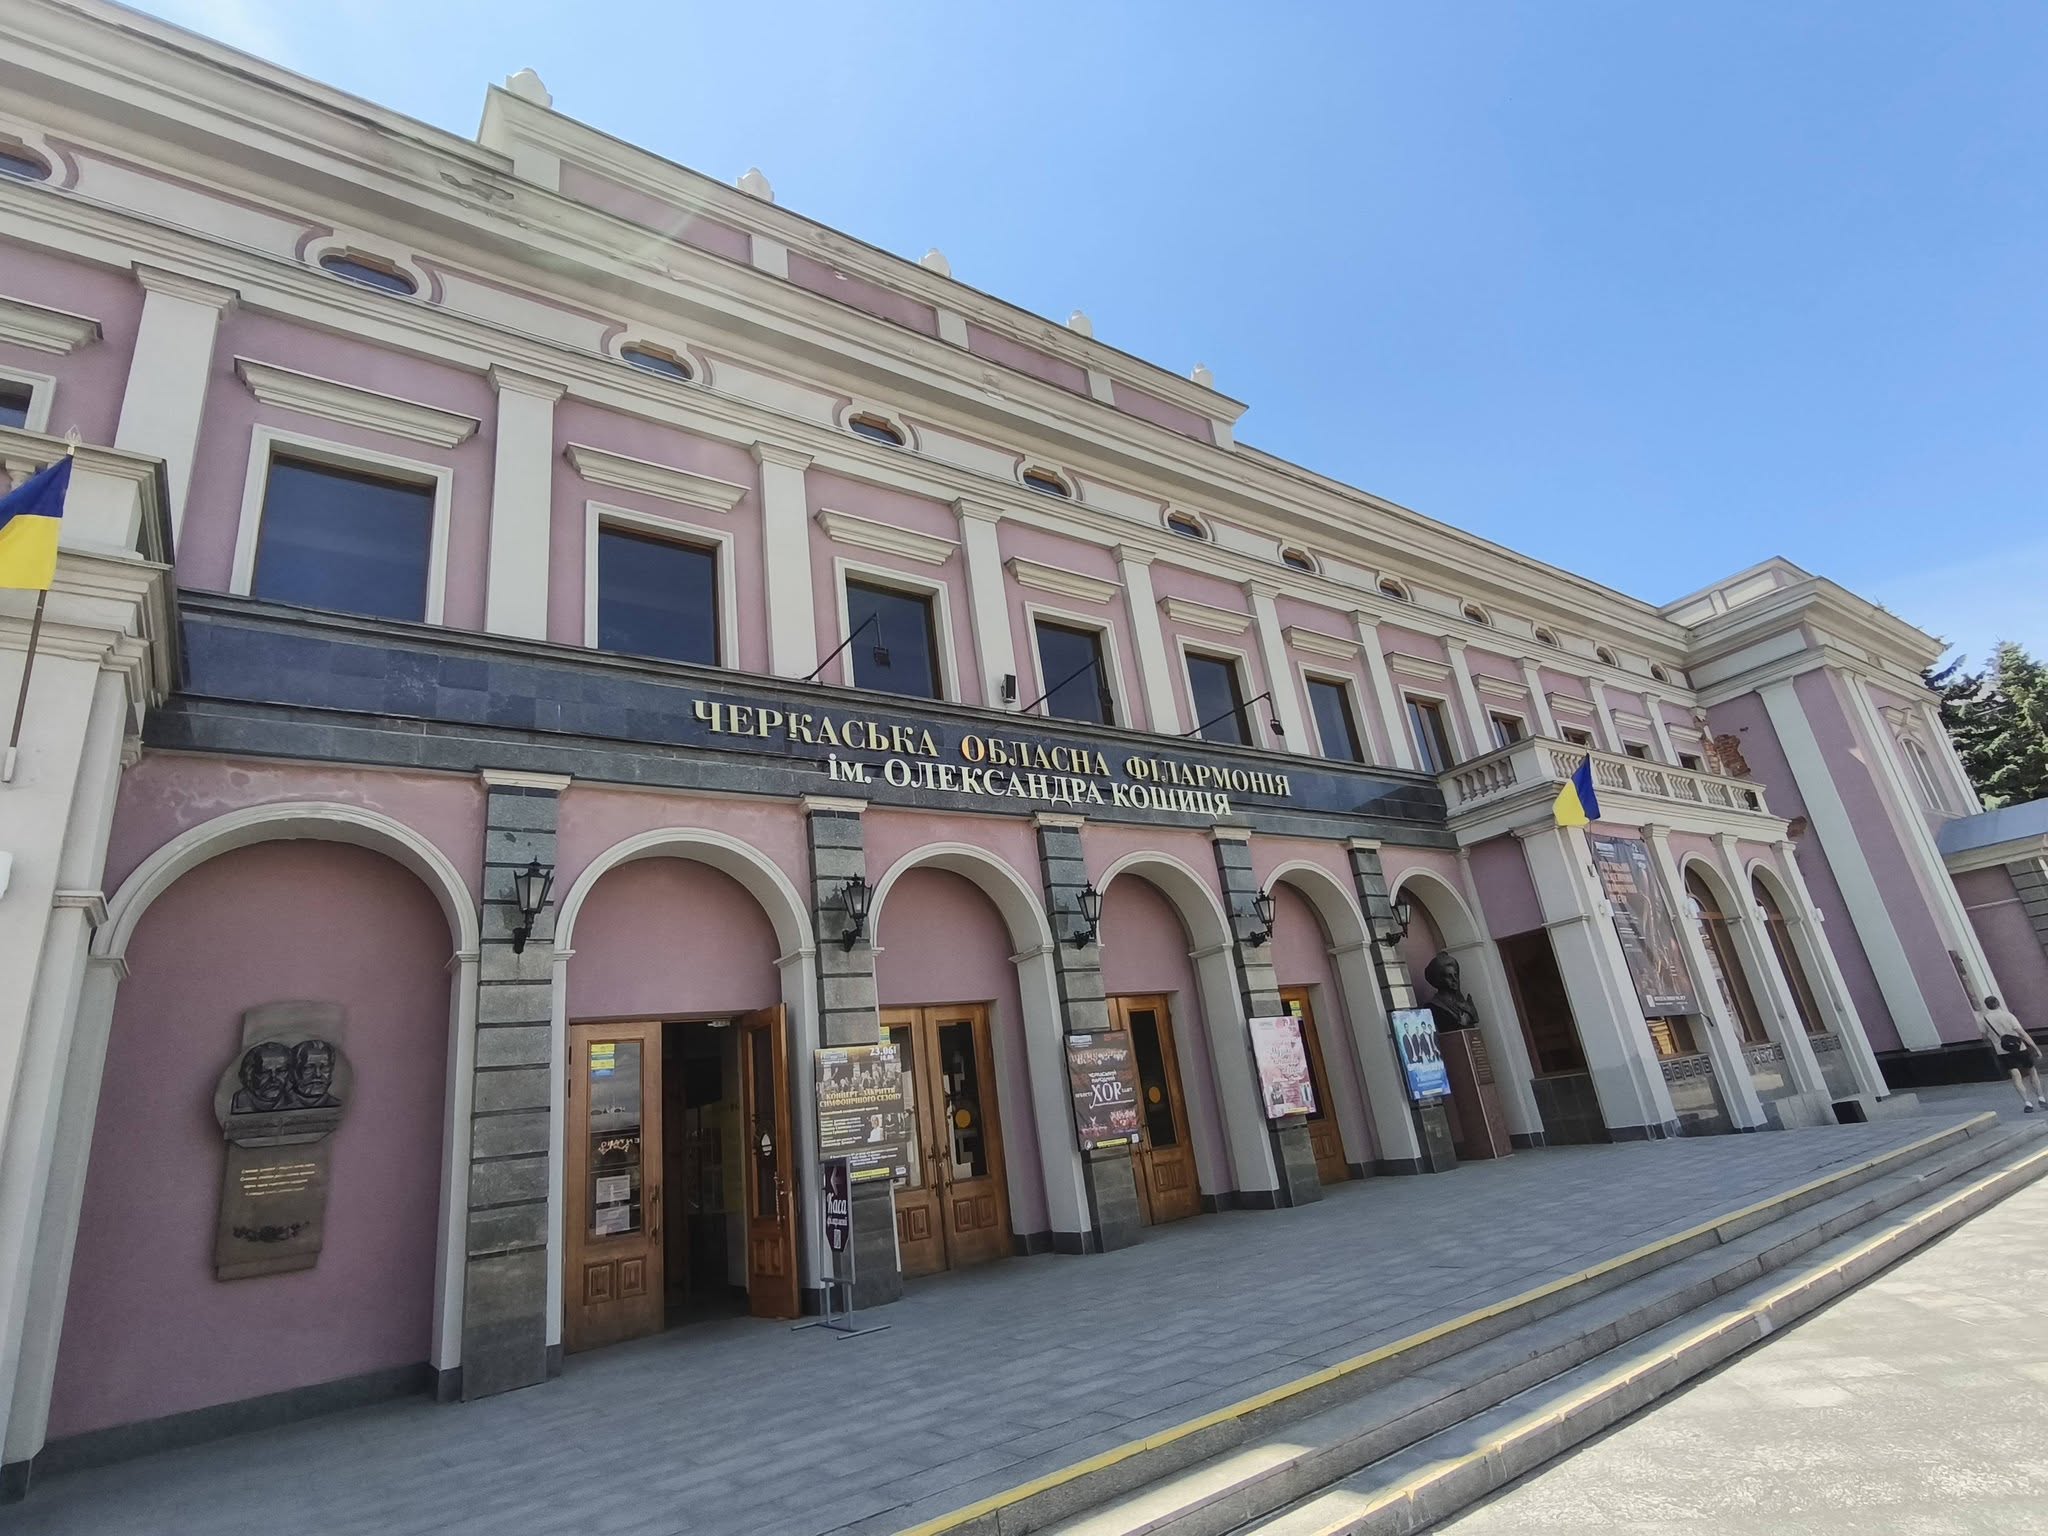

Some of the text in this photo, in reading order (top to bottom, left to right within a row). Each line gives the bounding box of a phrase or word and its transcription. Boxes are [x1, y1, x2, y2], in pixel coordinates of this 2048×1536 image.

[692, 699, 1292, 796] ЧЕРКАСЬКА ОБЛАСНА ФІЛАРМОНІЯ
[828, 753, 1232, 820] ім. ОЛЕКСАНДРА КОШИЦЯ
